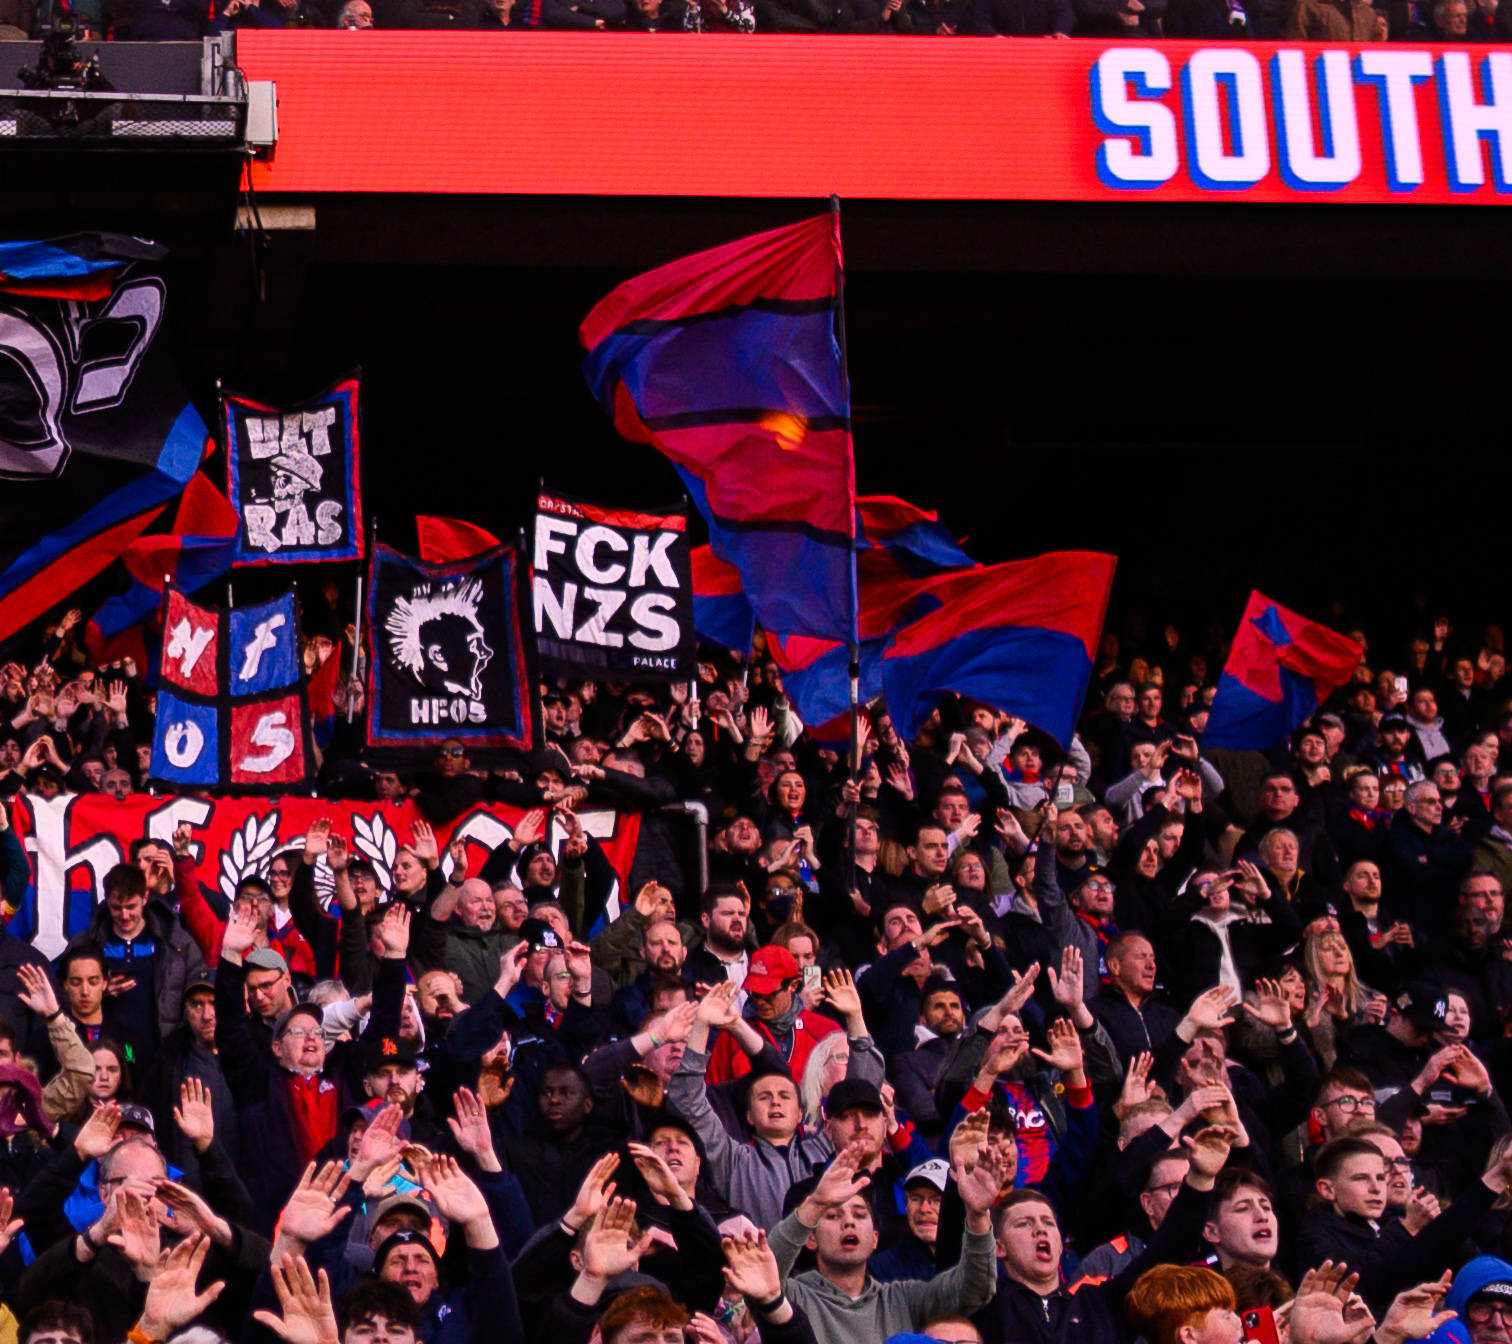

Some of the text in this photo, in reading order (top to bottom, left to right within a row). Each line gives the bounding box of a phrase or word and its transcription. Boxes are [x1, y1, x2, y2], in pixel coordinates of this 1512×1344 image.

[243, 501, 344, 553] RAS
[534, 514, 680, 588] FCK
[533, 576, 681, 652] NZS
[633, 656, 677, 670] PALACE
